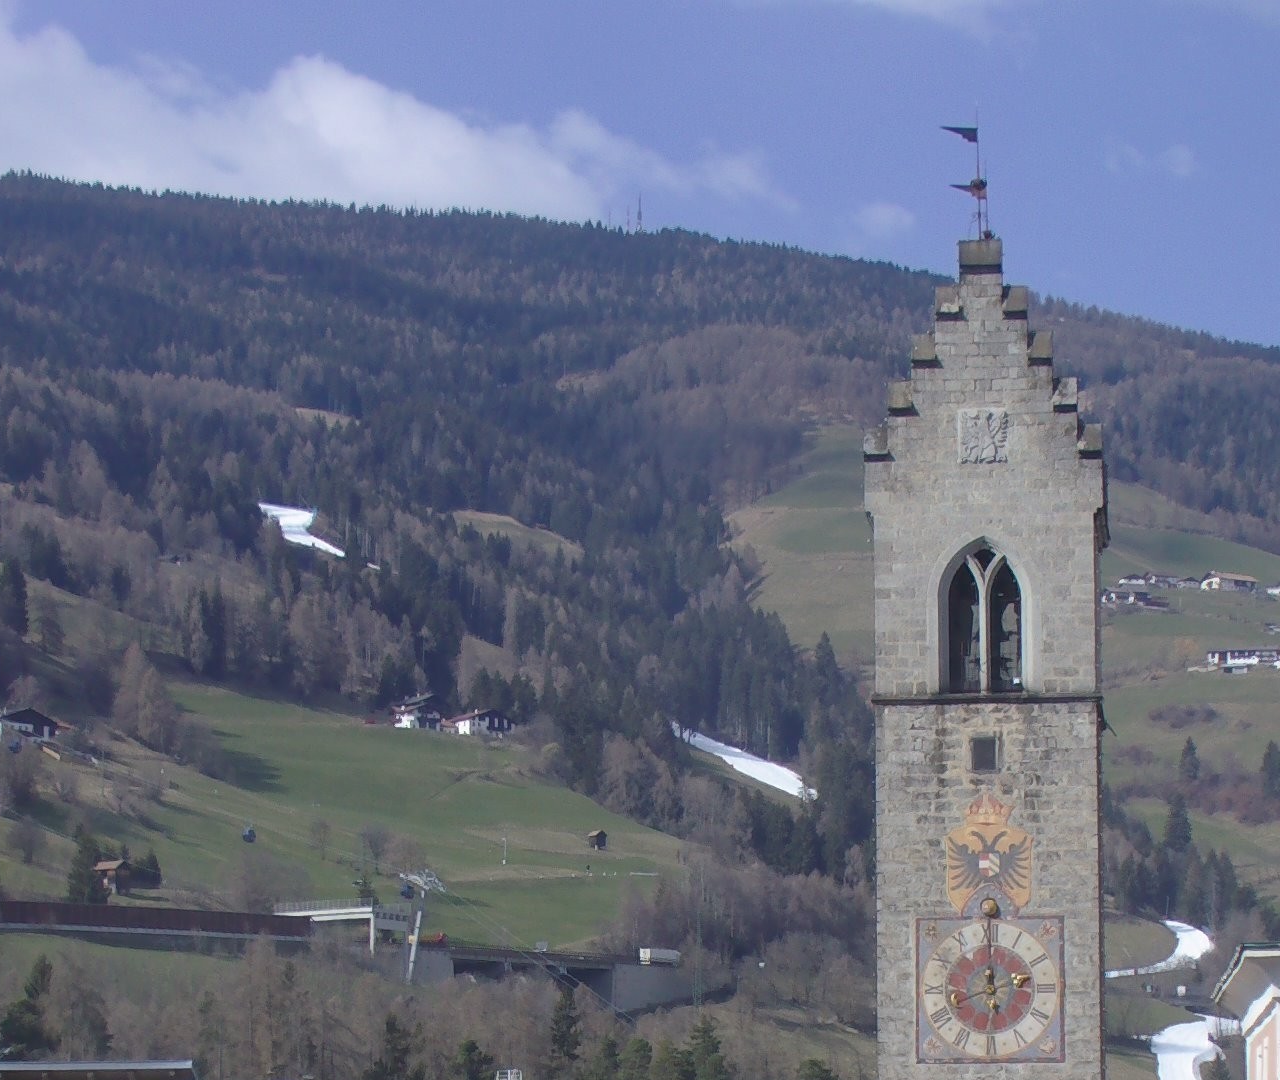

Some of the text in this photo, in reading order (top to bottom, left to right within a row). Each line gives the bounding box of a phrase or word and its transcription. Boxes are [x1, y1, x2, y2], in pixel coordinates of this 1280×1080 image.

[952, 931, 968, 952] XI
[981, 923, 999, 943] XII
[1012, 931, 1022, 948] I
[1029, 952, 1048, 968] II
[925, 984, 943, 994] IX
[1037, 983, 1056, 993] III
[930, 1005, 952, 1030] VIII
[1030, 1007, 1050, 1027] IV
[953, 1027, 970, 1049] VII
[986, 1036, 997, 1055] VI
[1013, 1029, 1028, 1048] V
